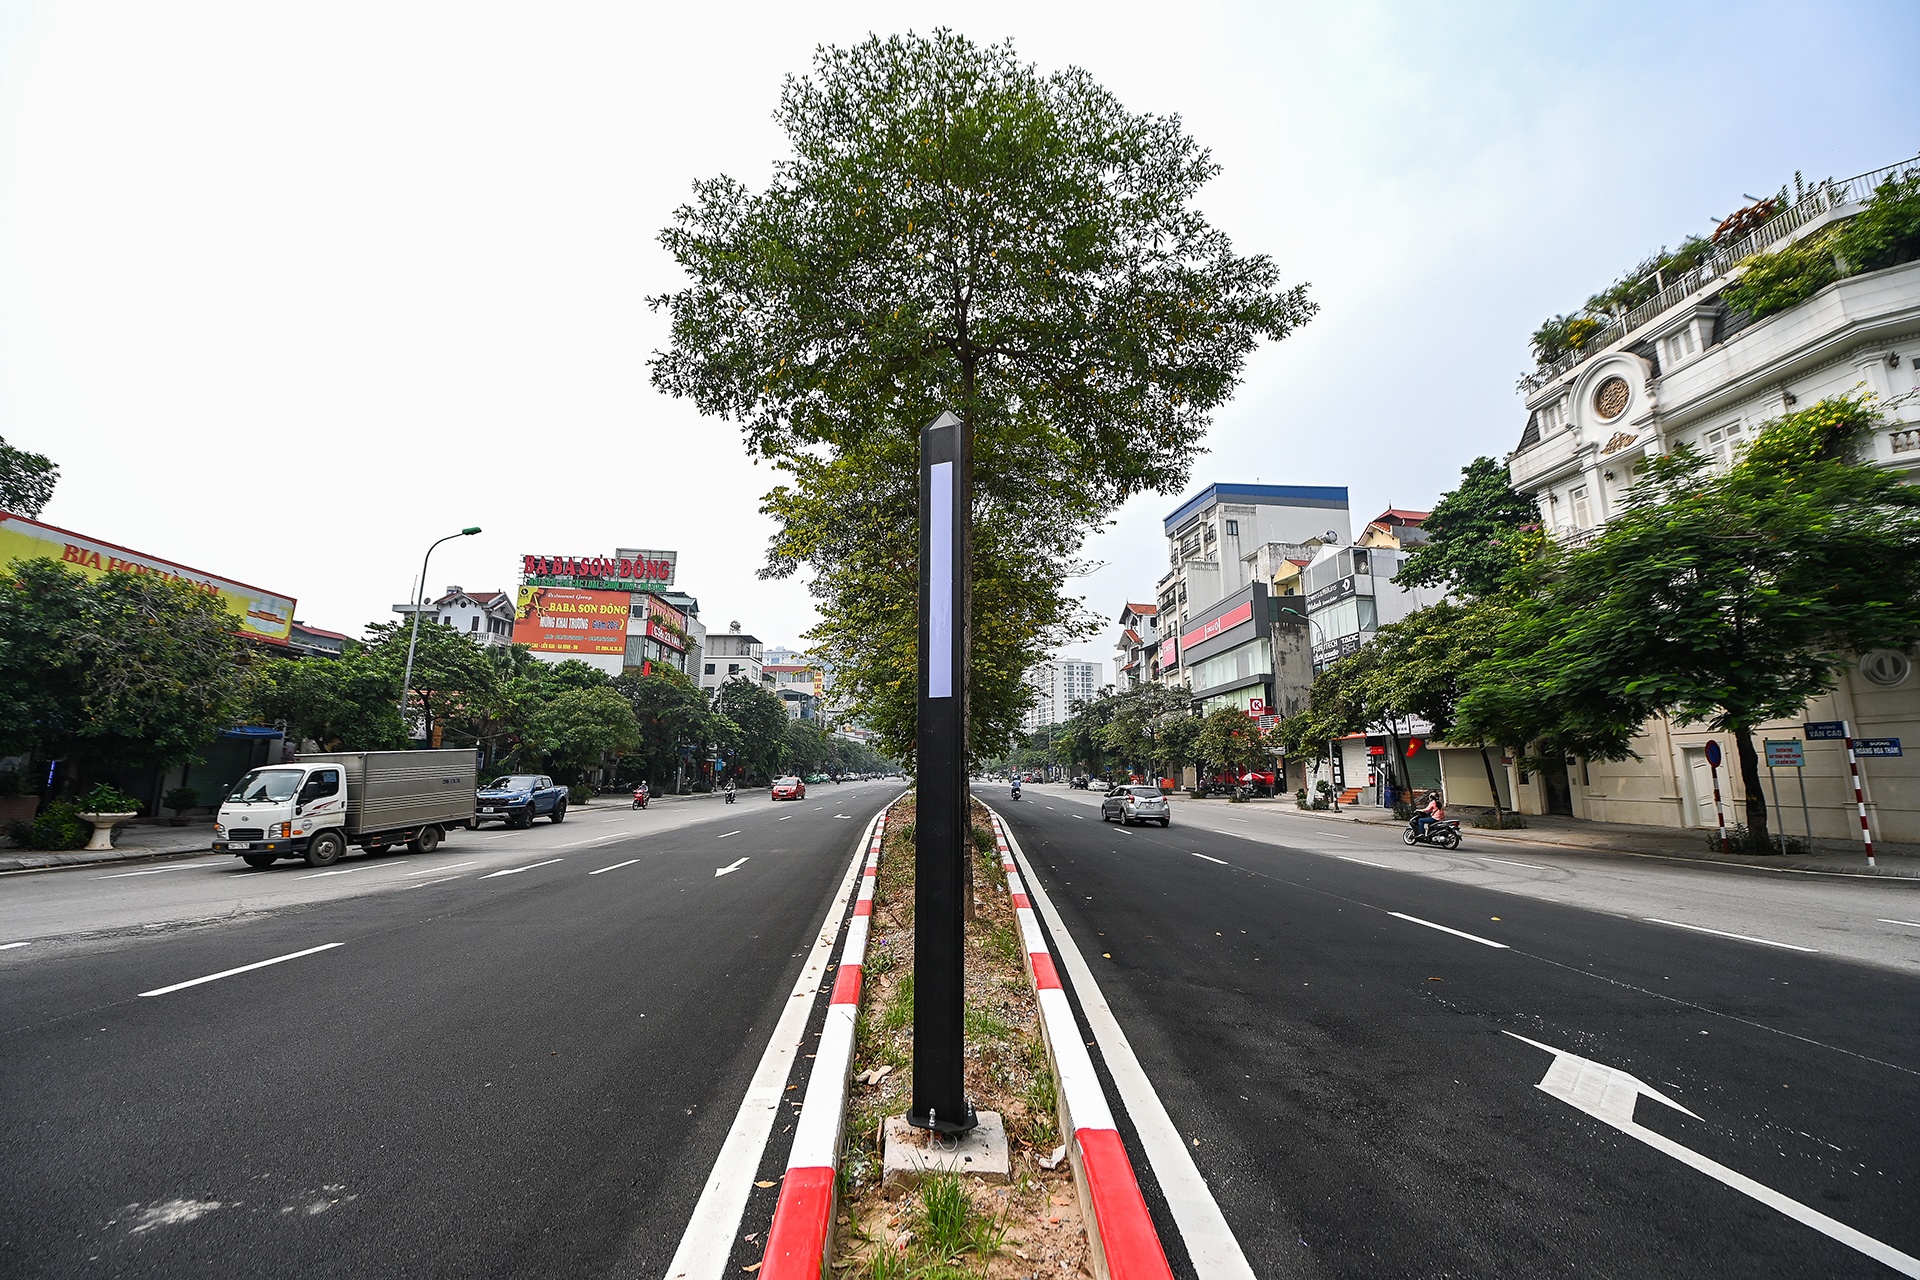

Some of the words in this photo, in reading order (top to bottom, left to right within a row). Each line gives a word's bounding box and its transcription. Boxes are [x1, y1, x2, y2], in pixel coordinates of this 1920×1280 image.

[60, 543, 102, 571] BIA
[524, 555, 548, 575] BA
[551, 556, 576, 576] BA
[579, 554, 615, 577] SƠN
[619, 553, 670, 579] ĐÔNG
[549, 602, 576, 613] BABA
[577, 603, 598, 614] SƠN
[600, 602, 628, 615] ĐÔNG
